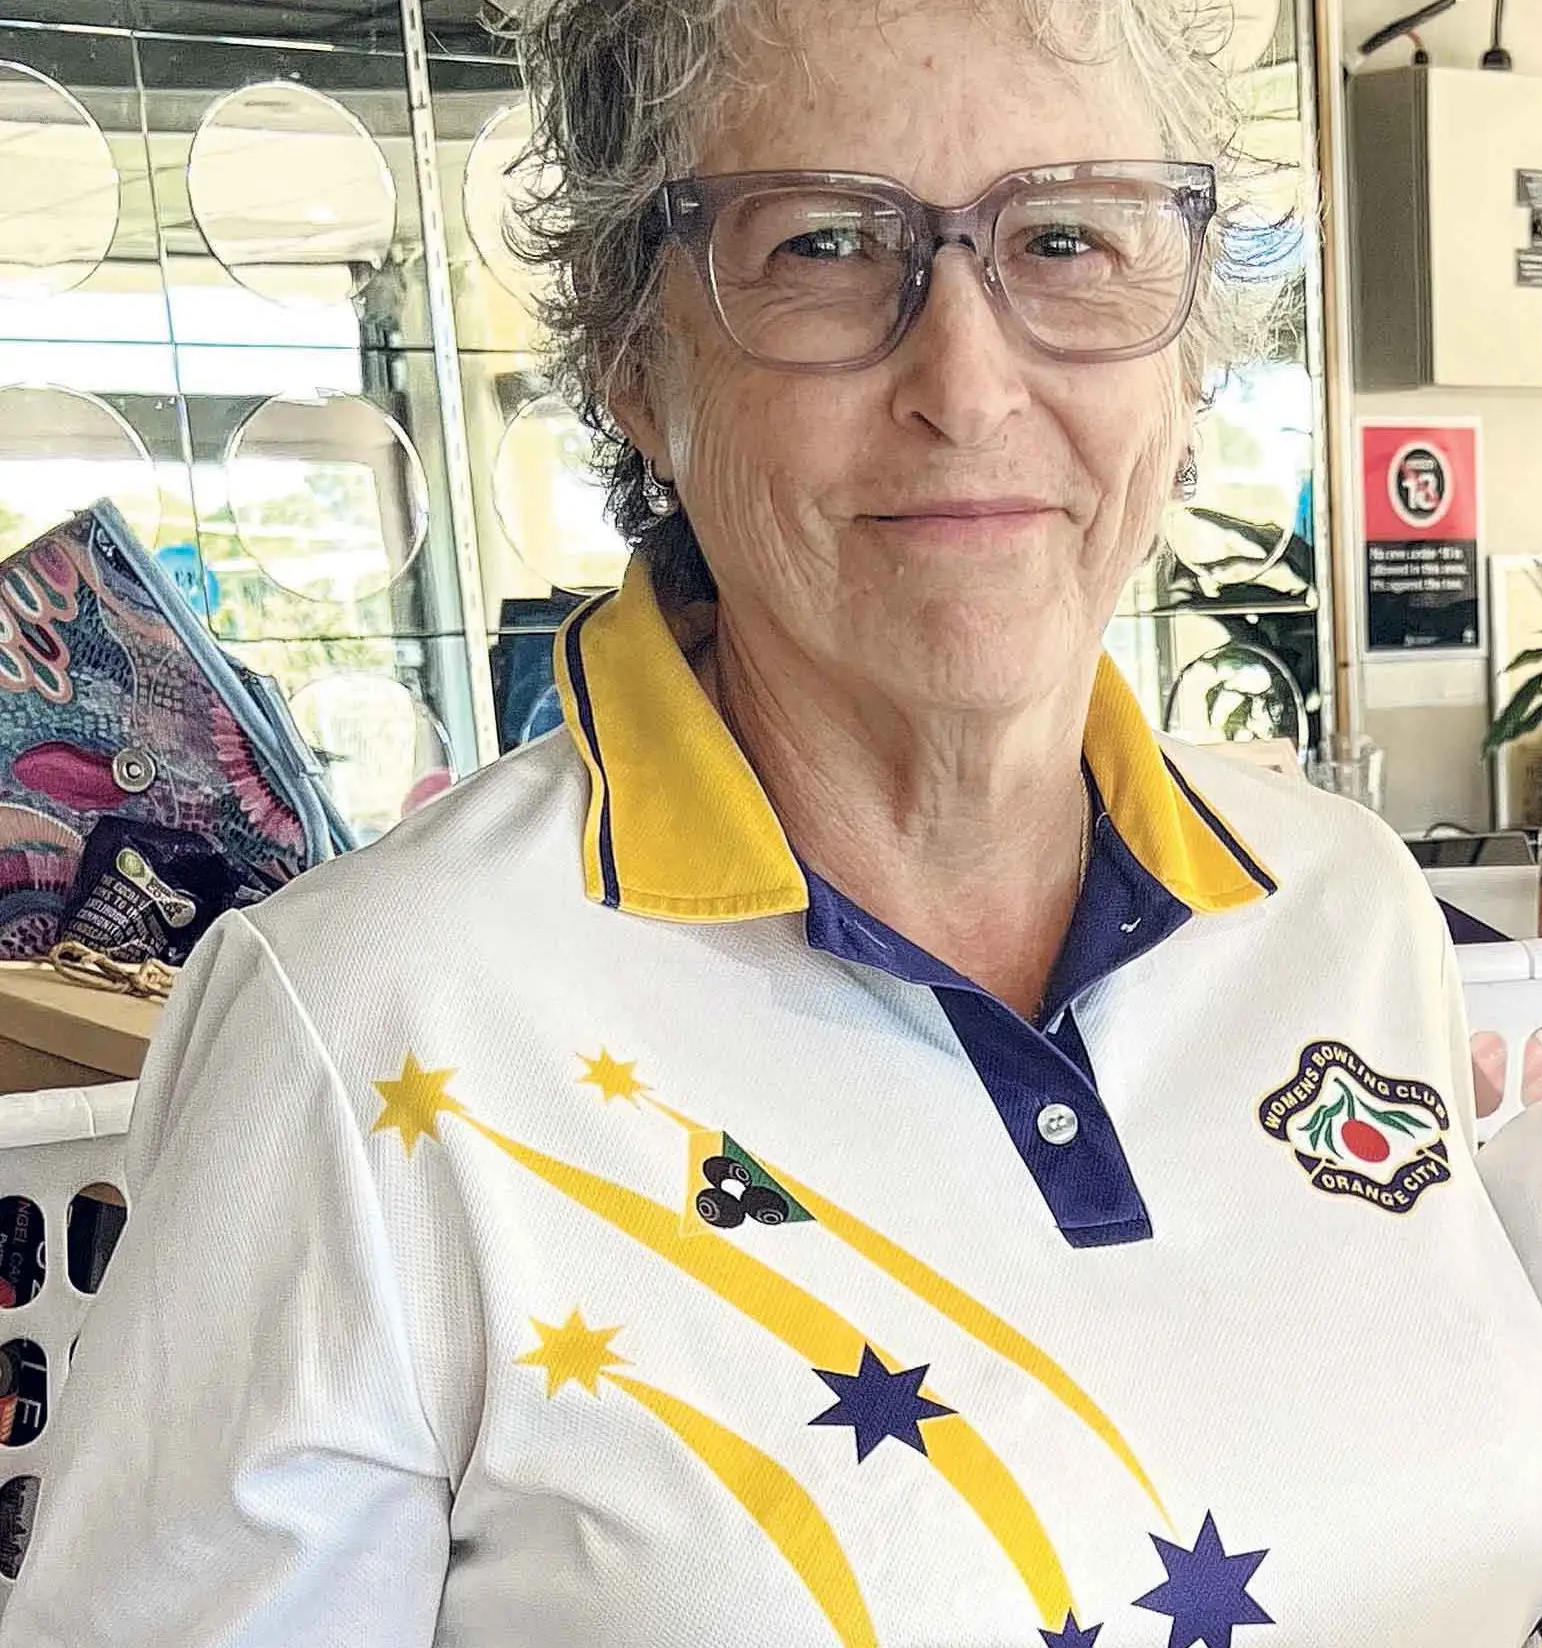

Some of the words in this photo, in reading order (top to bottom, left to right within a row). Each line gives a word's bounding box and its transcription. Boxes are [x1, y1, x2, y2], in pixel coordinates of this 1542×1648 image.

[1264, 1067, 1319, 1130] WOMENS
[1311, 1046, 1391, 1097] BOWLING
[1396, 1084, 1446, 1119] CLUB
[1321, 1174, 1409, 1207] ORANGE
[1403, 1161, 1442, 1191] CITY
